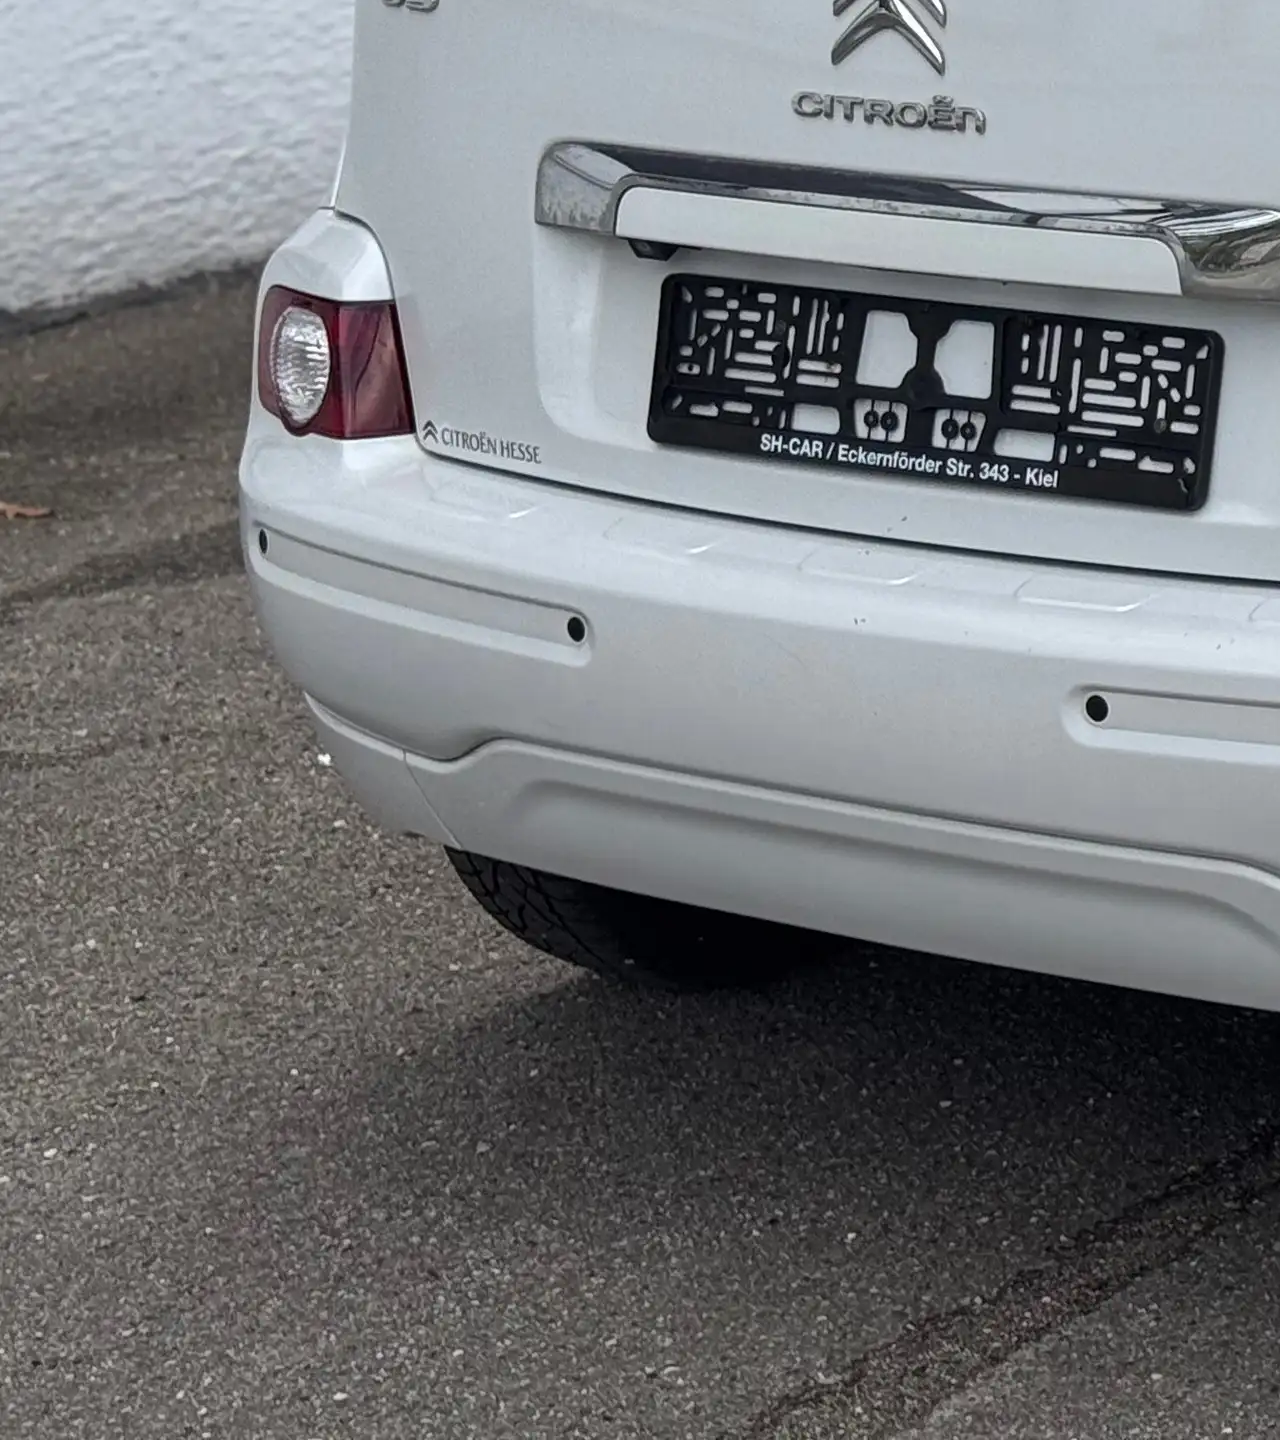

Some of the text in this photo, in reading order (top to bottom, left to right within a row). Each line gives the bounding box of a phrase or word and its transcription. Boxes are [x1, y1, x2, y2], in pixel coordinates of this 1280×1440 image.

[441, 427, 542, 464] CITROËN HESSE
[760, 433, 823, 458] SH-CAR
[838, 446, 943, 474] Eckernförder
[946, 458, 975, 479] Str.
[979, 463, 1010, 483] 343
[1025, 468, 1059, 489] Kiel
